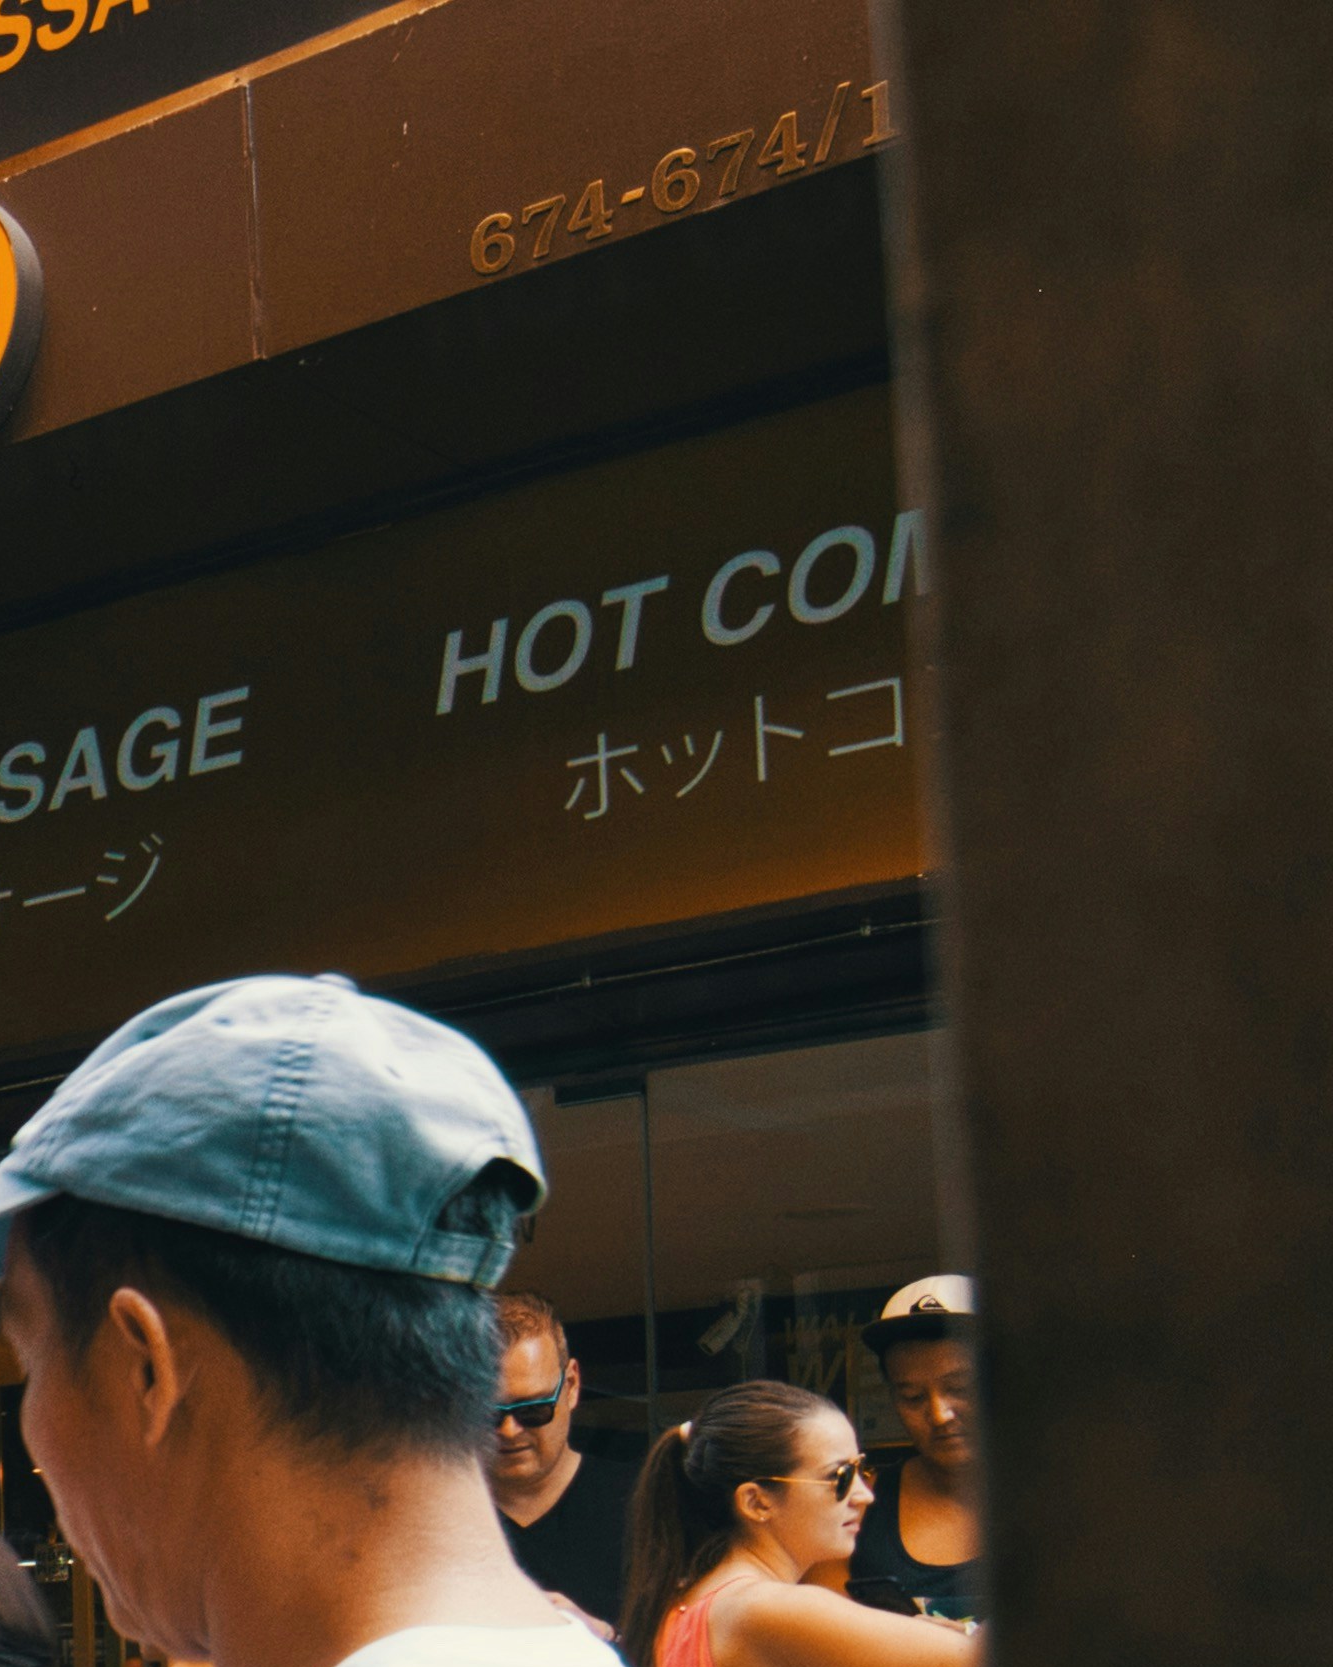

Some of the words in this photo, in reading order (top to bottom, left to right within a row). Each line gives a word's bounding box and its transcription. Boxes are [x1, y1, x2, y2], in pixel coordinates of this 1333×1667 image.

[436, 575, 671, 717] HOT
[564, 676, 904, 820] ホットコ
